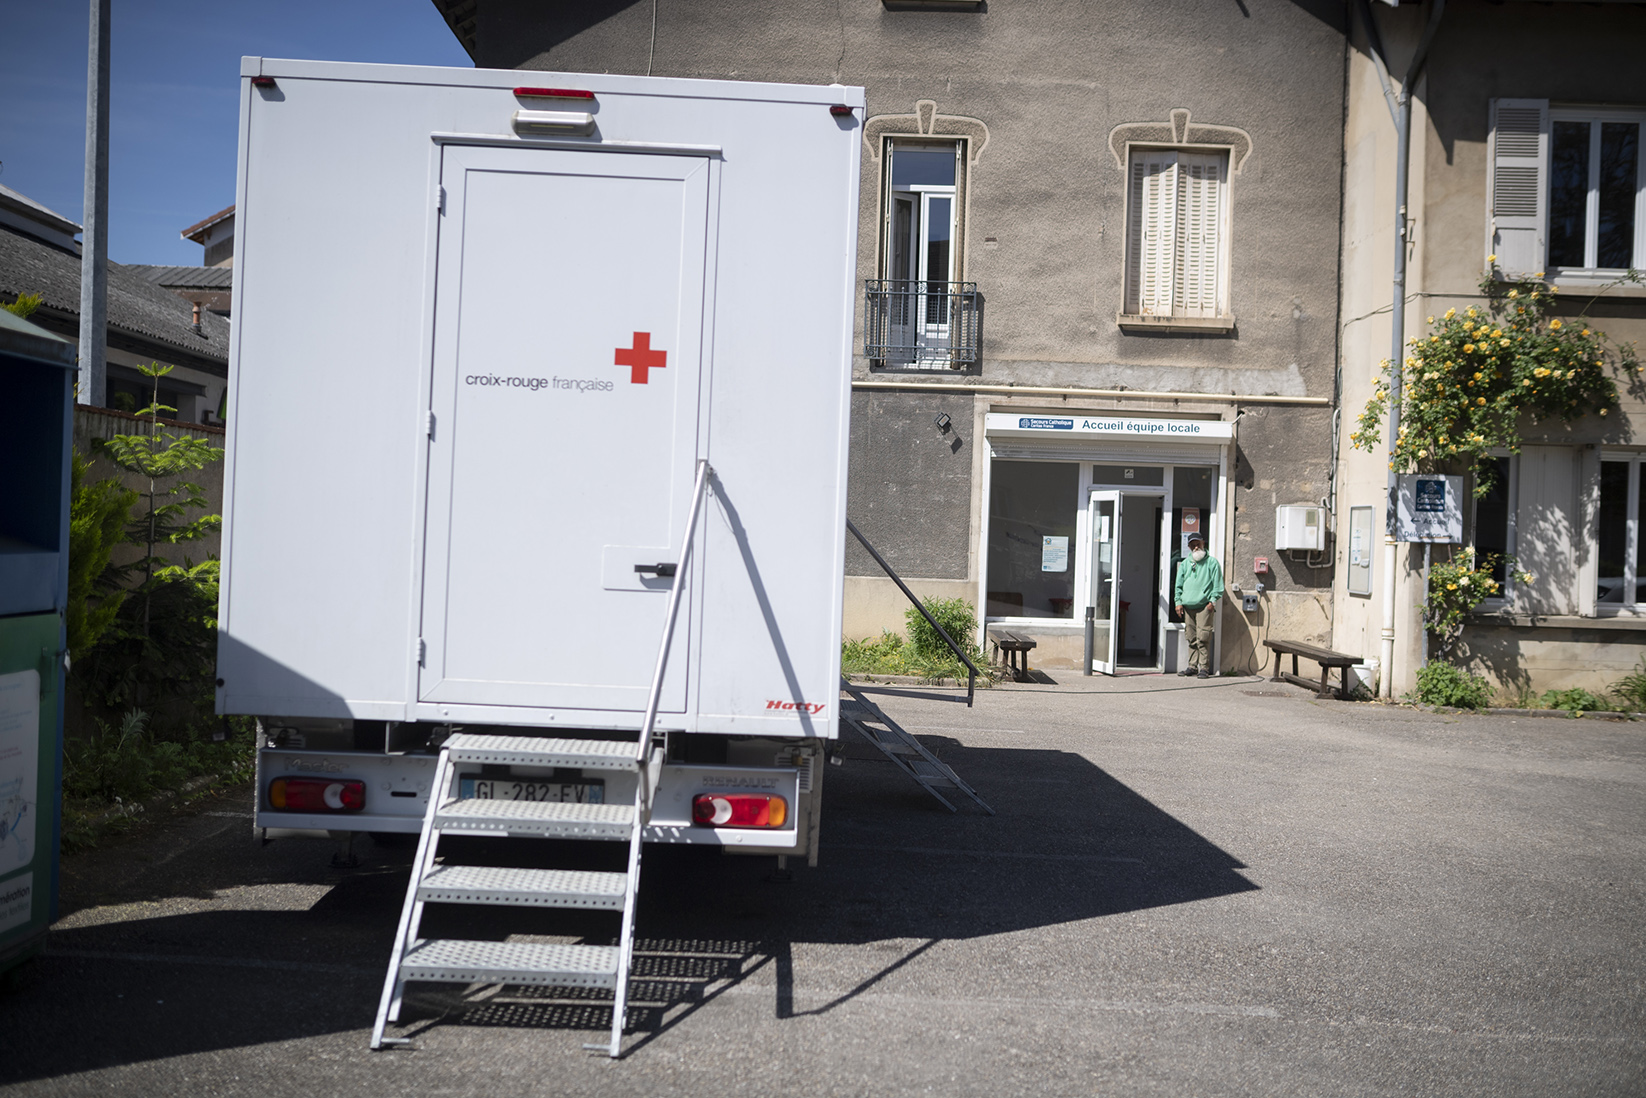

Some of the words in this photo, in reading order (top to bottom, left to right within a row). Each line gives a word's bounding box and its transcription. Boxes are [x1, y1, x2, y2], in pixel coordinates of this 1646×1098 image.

[465, 373, 549, 391] croix-rouge
[552, 376, 614, 393] française
[1082, 419, 1124, 431] Accueil
[1127, 421, 1164, 433] équipe
[1167, 423, 1201, 433] locale
[765, 700, 826, 714] Hatty
[284, 757, 350, 773] Master
[702, 776, 779, 788] RENAULT
